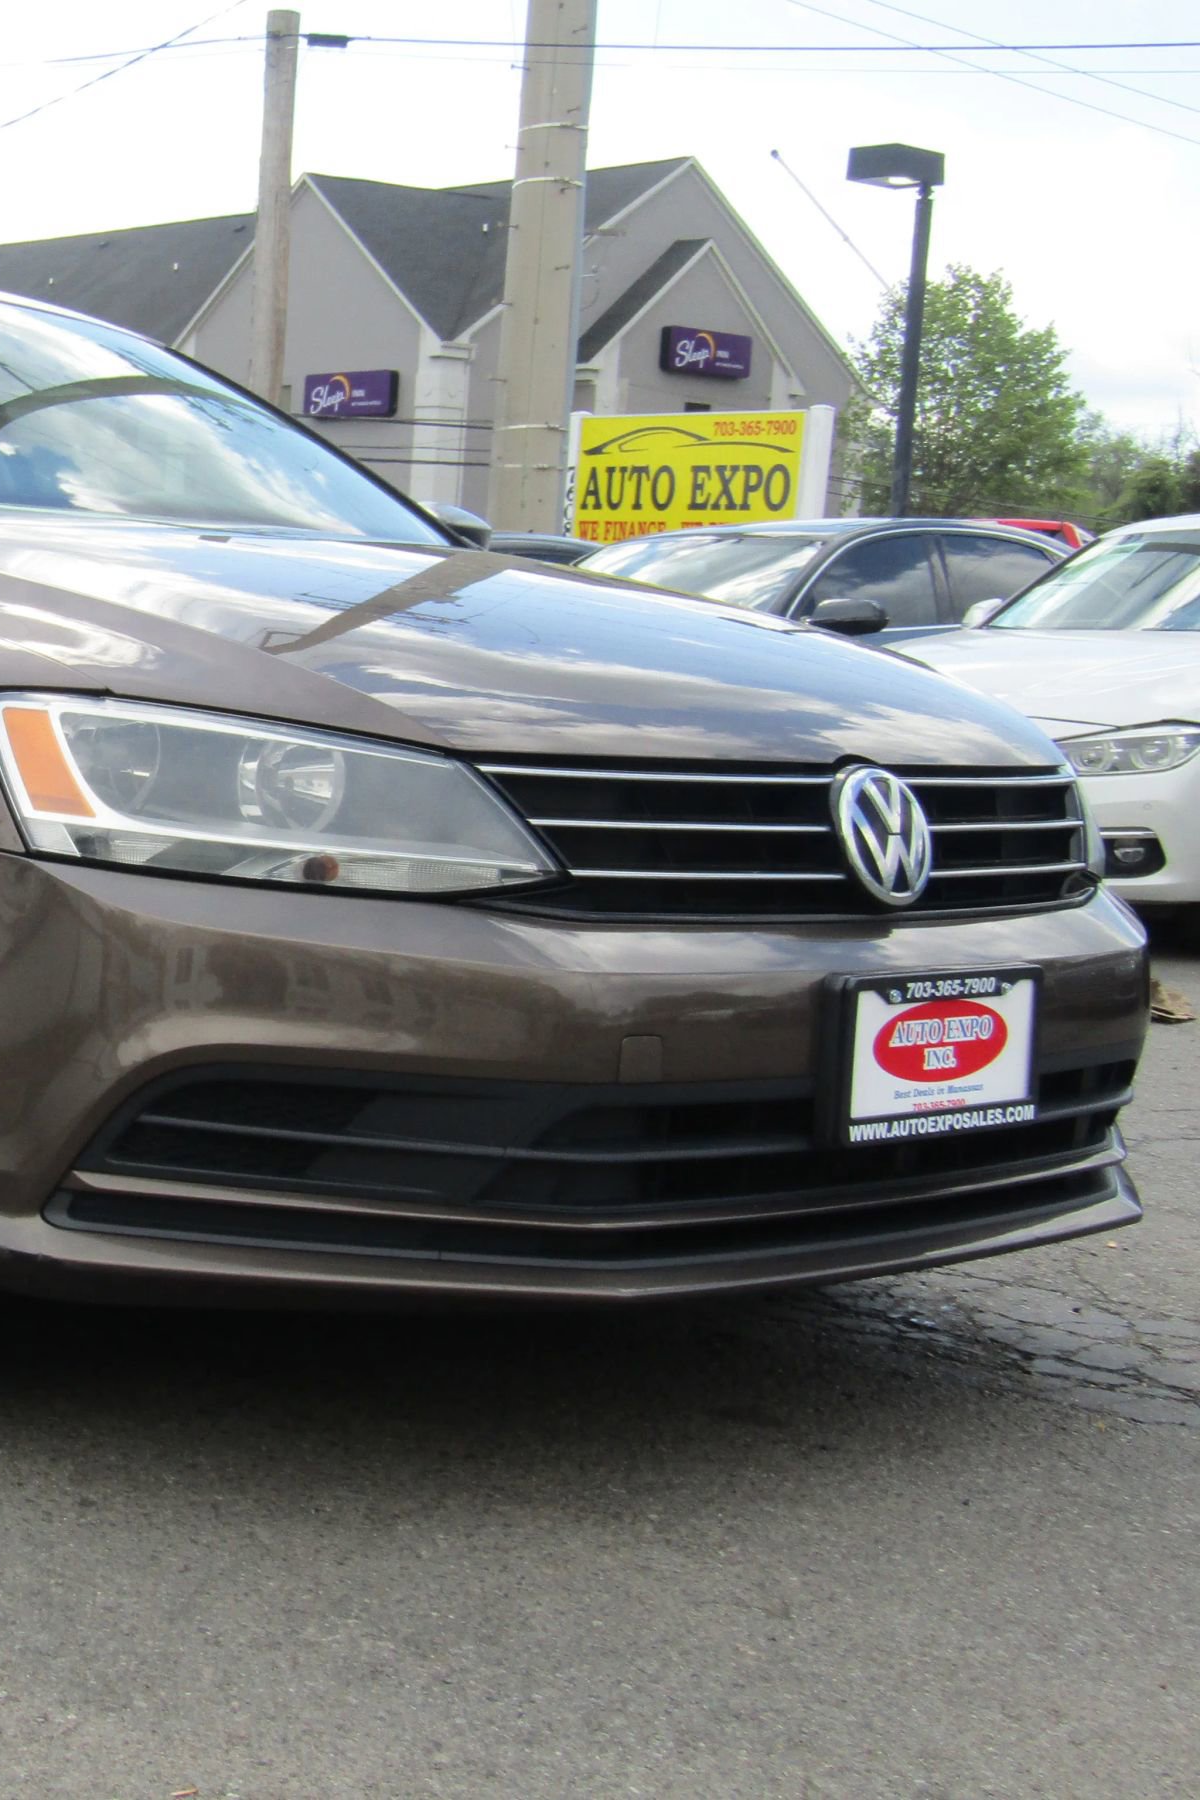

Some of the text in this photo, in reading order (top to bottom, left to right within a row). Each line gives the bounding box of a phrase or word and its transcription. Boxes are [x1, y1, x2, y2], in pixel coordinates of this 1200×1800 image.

[675, 340, 709, 368] Sleep
[310, 384, 344, 414] Sleep
[714, 420, 797, 436] 703-365-7900
[580, 464, 791, 512] AUTO EXPO
[579, 520, 599, 541] WE
[906, 977, 996, 998] 703-365-7900
[890, 1015, 993, 1046] AUTO EXPO
[924, 1047, 957, 1070] INC.
[849, 1104, 1035, 1142] WWW.AUTOEXPOSALES.COM
